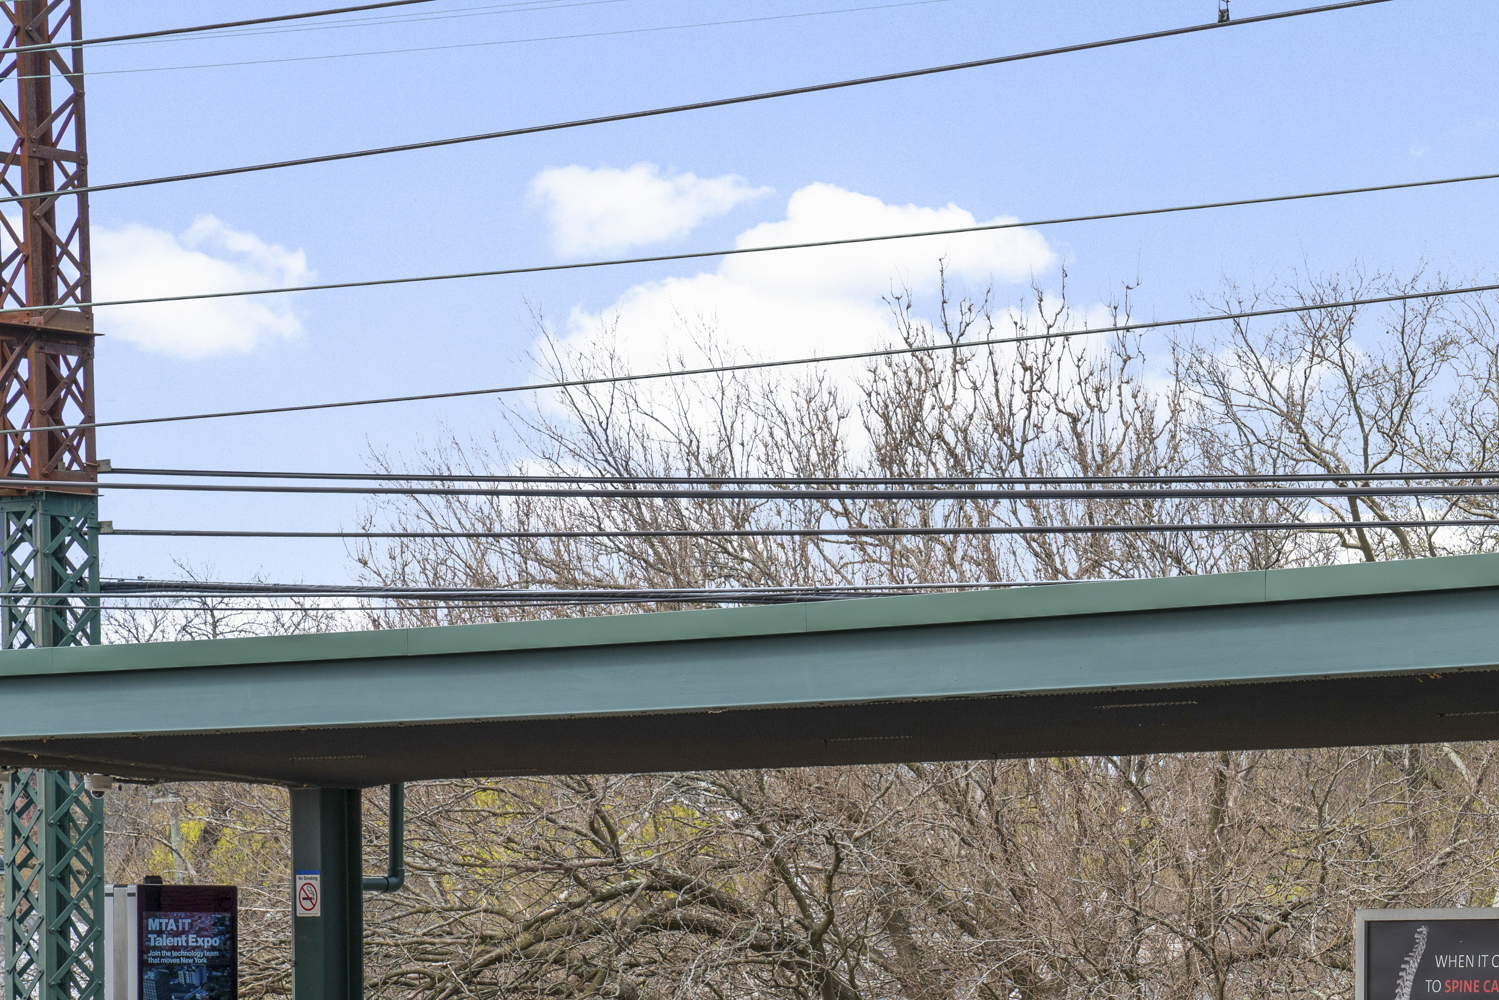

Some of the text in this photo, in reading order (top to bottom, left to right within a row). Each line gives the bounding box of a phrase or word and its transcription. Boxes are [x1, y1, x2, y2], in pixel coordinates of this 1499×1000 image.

[148, 918, 191, 931] MTA IT
[148, 934, 220, 948] Talent Expo
[1435, 955, 1474, 968] WHEN
[1478, 955, 1489, 968] IT
[1425, 980, 1442, 993] TO
[1444, 980, 1480, 993] SPINE
